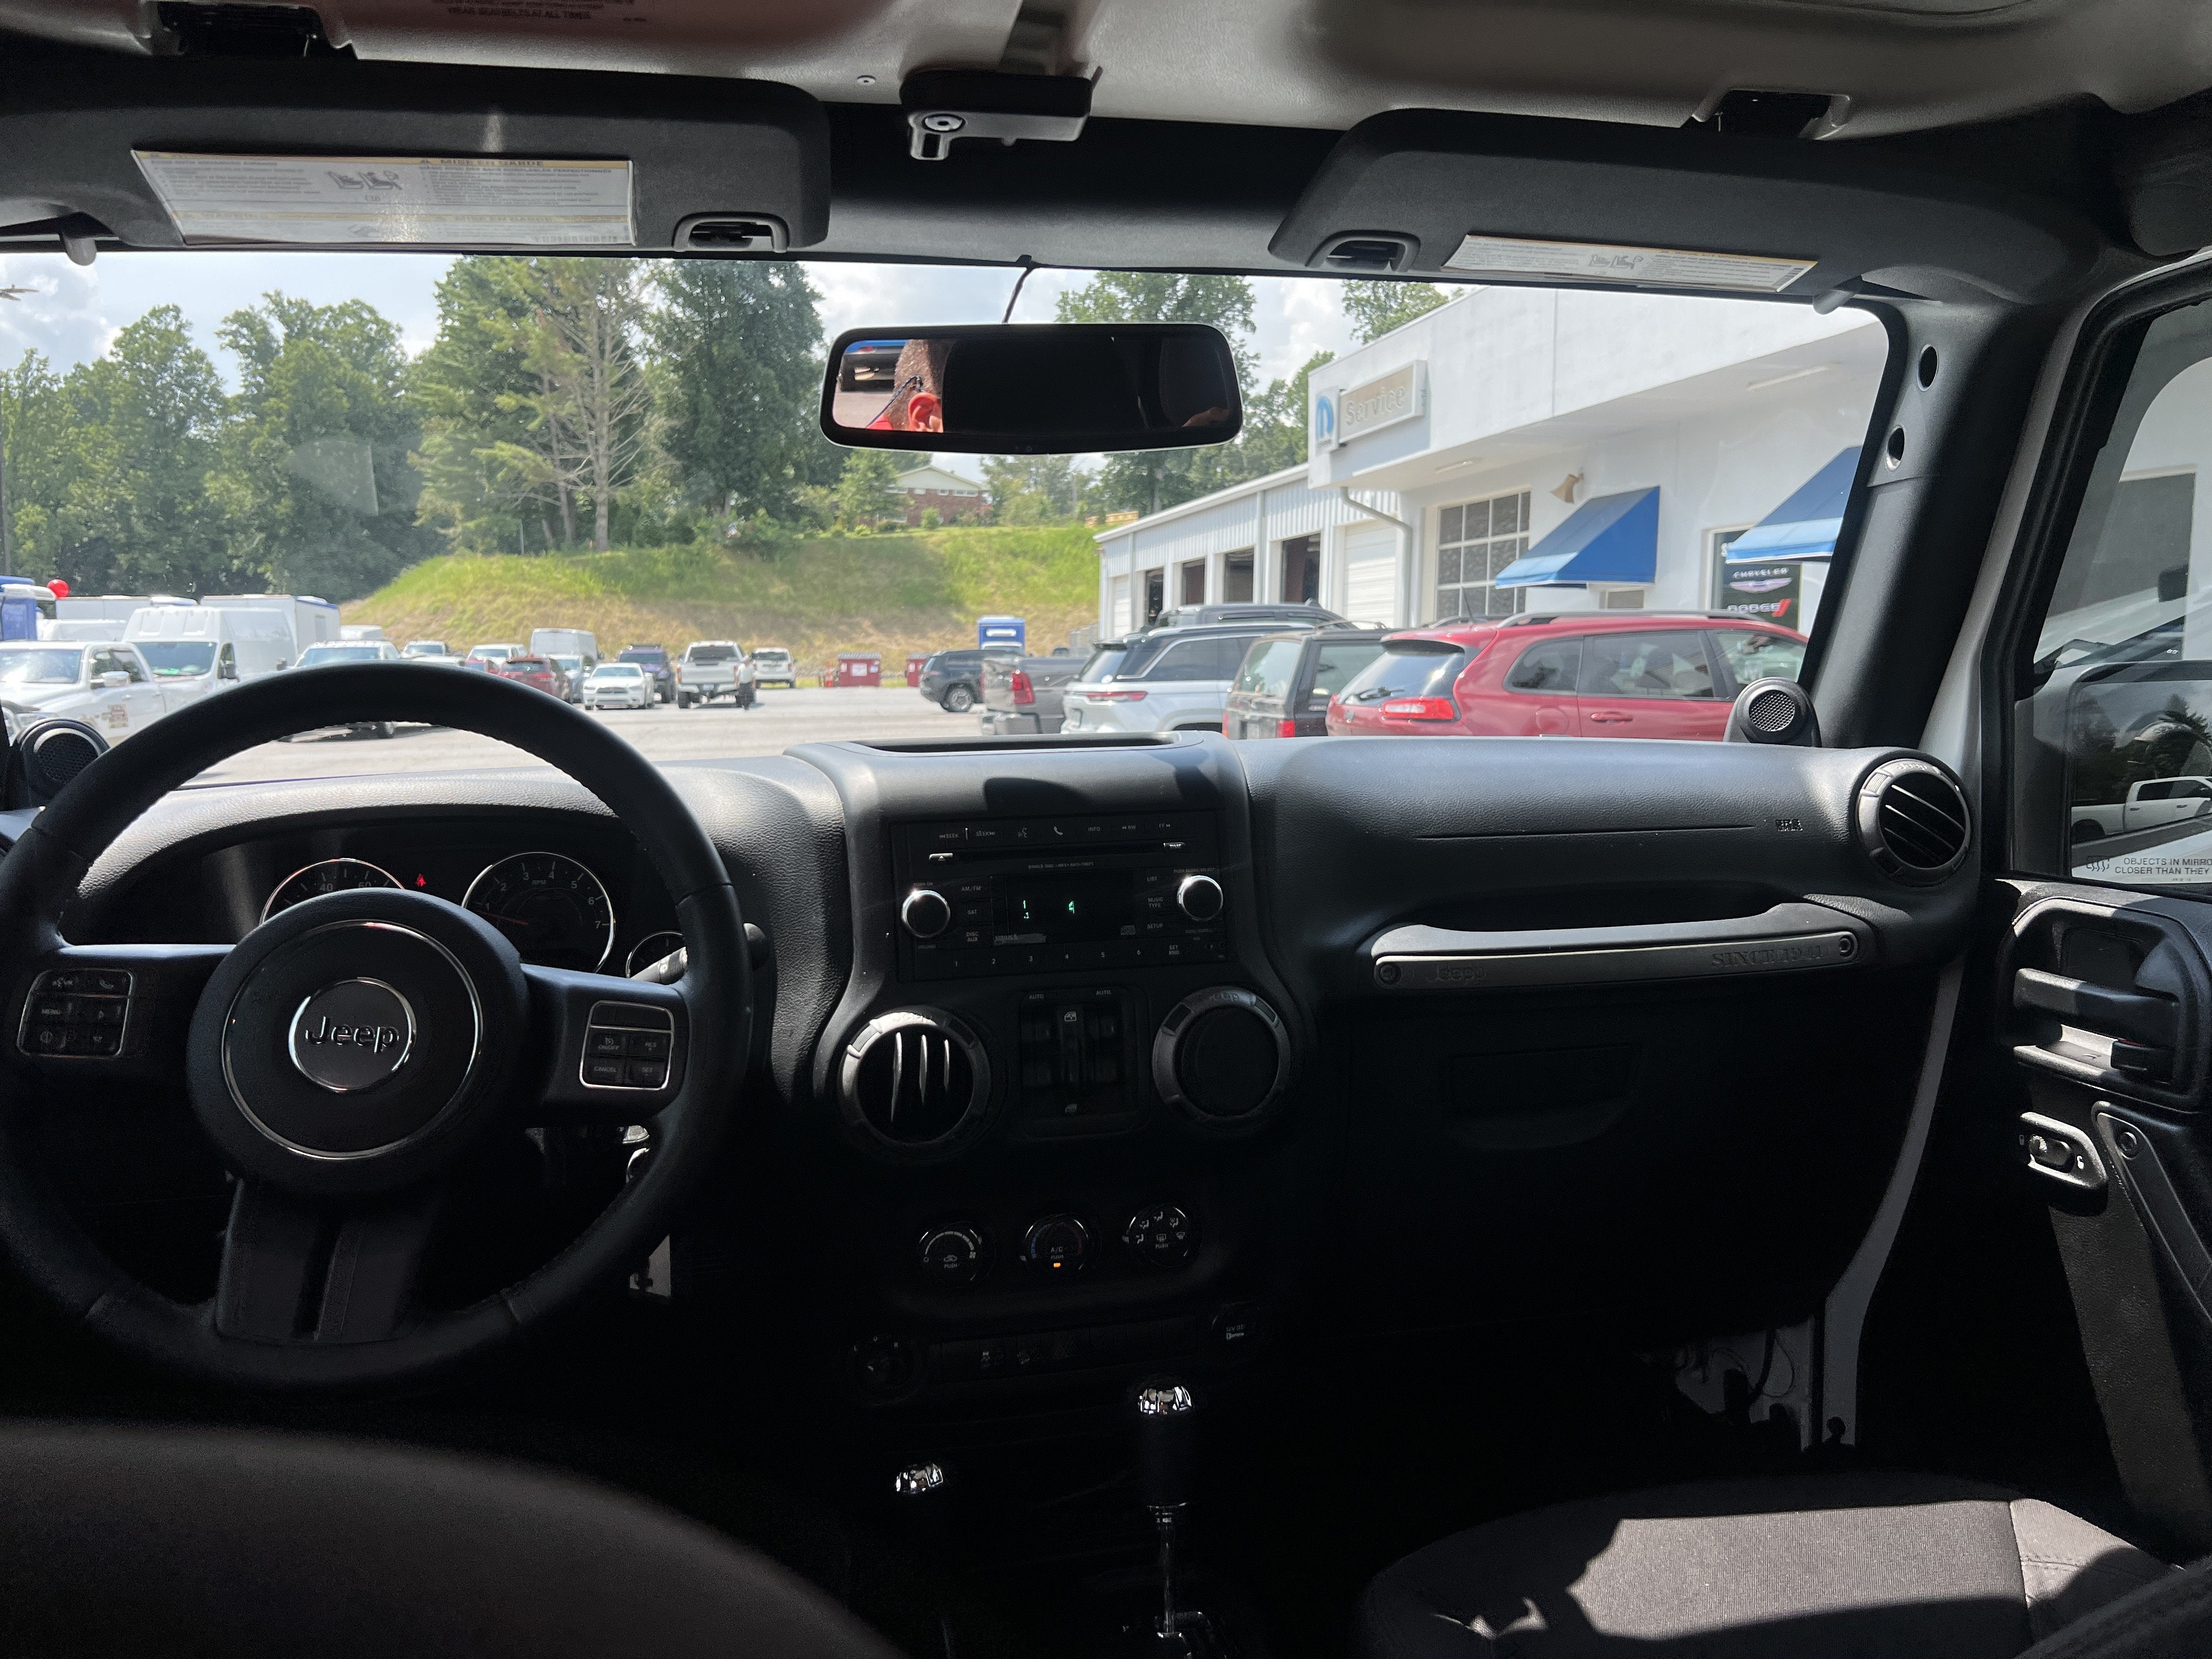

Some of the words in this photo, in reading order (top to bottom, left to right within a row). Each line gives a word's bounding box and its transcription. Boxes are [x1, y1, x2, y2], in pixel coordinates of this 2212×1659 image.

[1346, 386, 1406, 426] Service
[1728, 602, 1781, 614] DODGE
[318, 883, 333, 892] 40
[500, 883, 507, 891] 2
[571, 881, 578, 889] 5
[588, 897, 595, 905] 6
[595, 920, 602, 929] 7
[305, 1016, 399, 1054] Jeep
